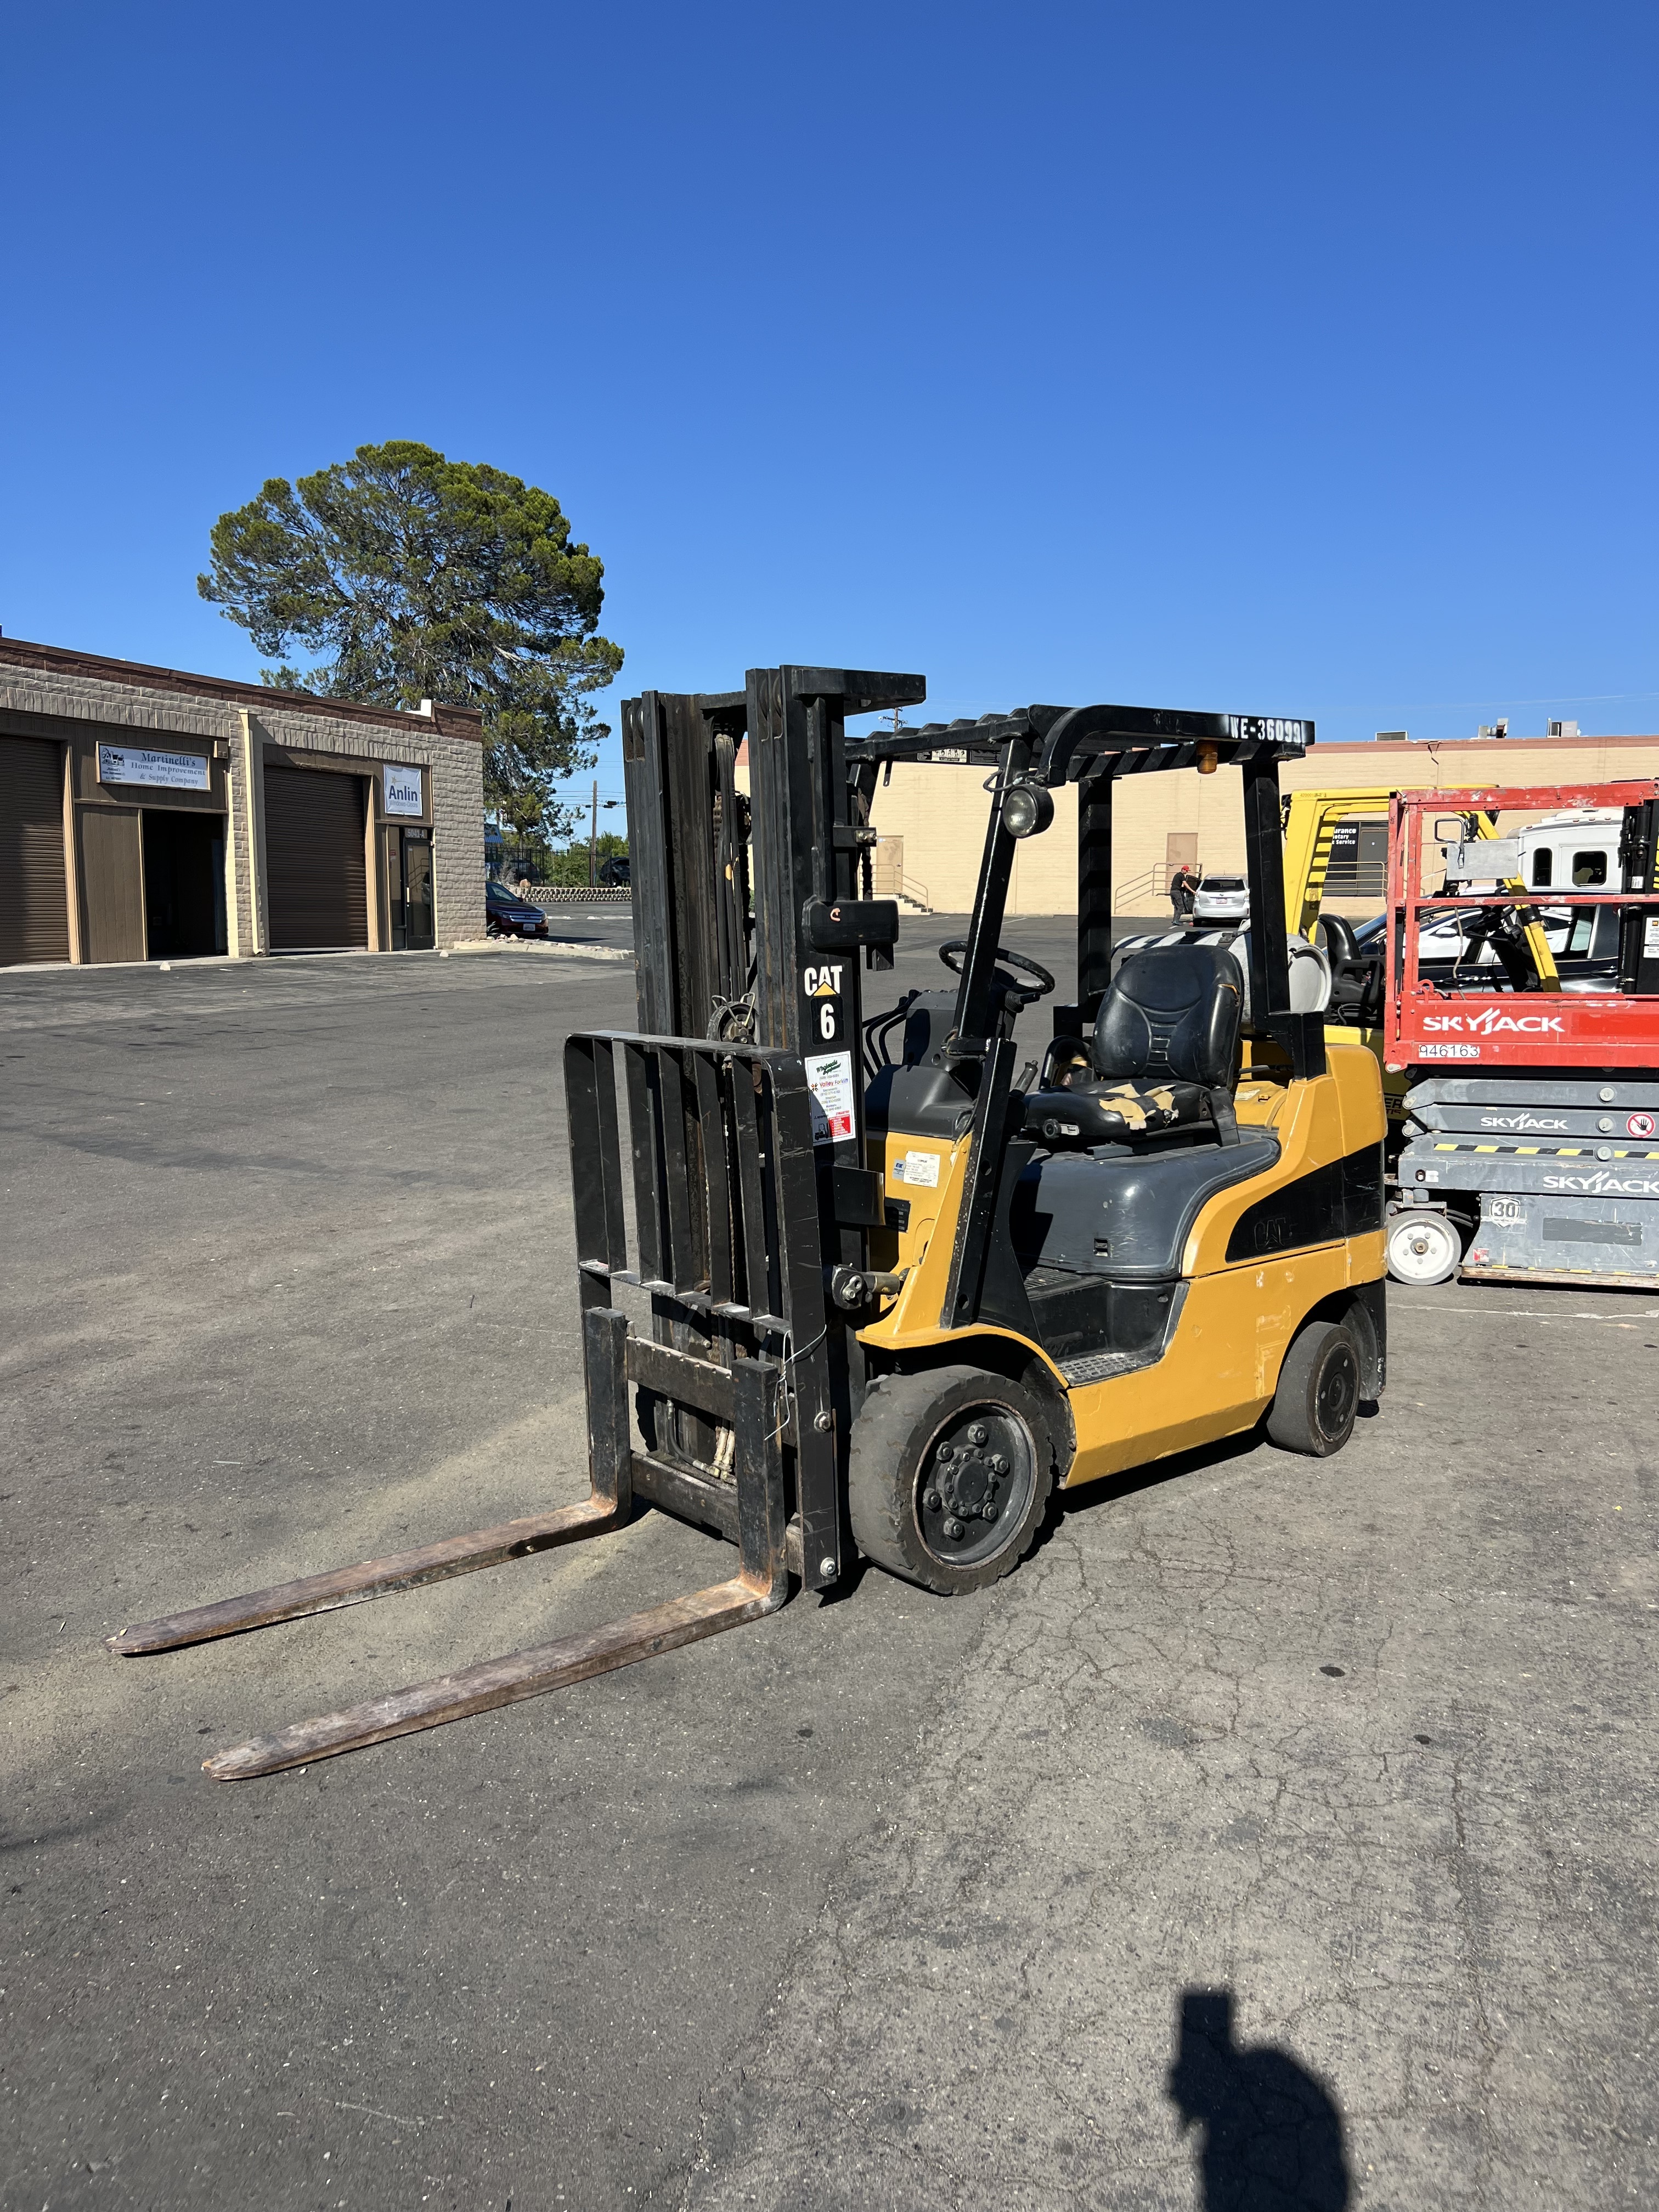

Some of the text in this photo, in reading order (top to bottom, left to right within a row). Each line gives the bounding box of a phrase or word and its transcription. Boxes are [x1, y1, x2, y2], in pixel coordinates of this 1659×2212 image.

[141, 753, 196, 767] Martinelli's
[131, 762, 154, 770] Home
[157, 765, 206, 776] Improvement
[149, 774, 169, 784] Supply
[171, 776, 198, 787] Company
[389, 785, 417, 802] Anlin
[804, 966, 843, 996] CAT
[821, 1003, 835, 1039] 6
[1423, 1007, 1565, 1035] SKYJACK
[1419, 1045, 1479, 1057] 946163
[1480, 1113, 1568, 1130] SKYJACK
[1543, 1171, 1659, 1194] SKYJACK
[1494, 1201, 1515, 1217] 30
